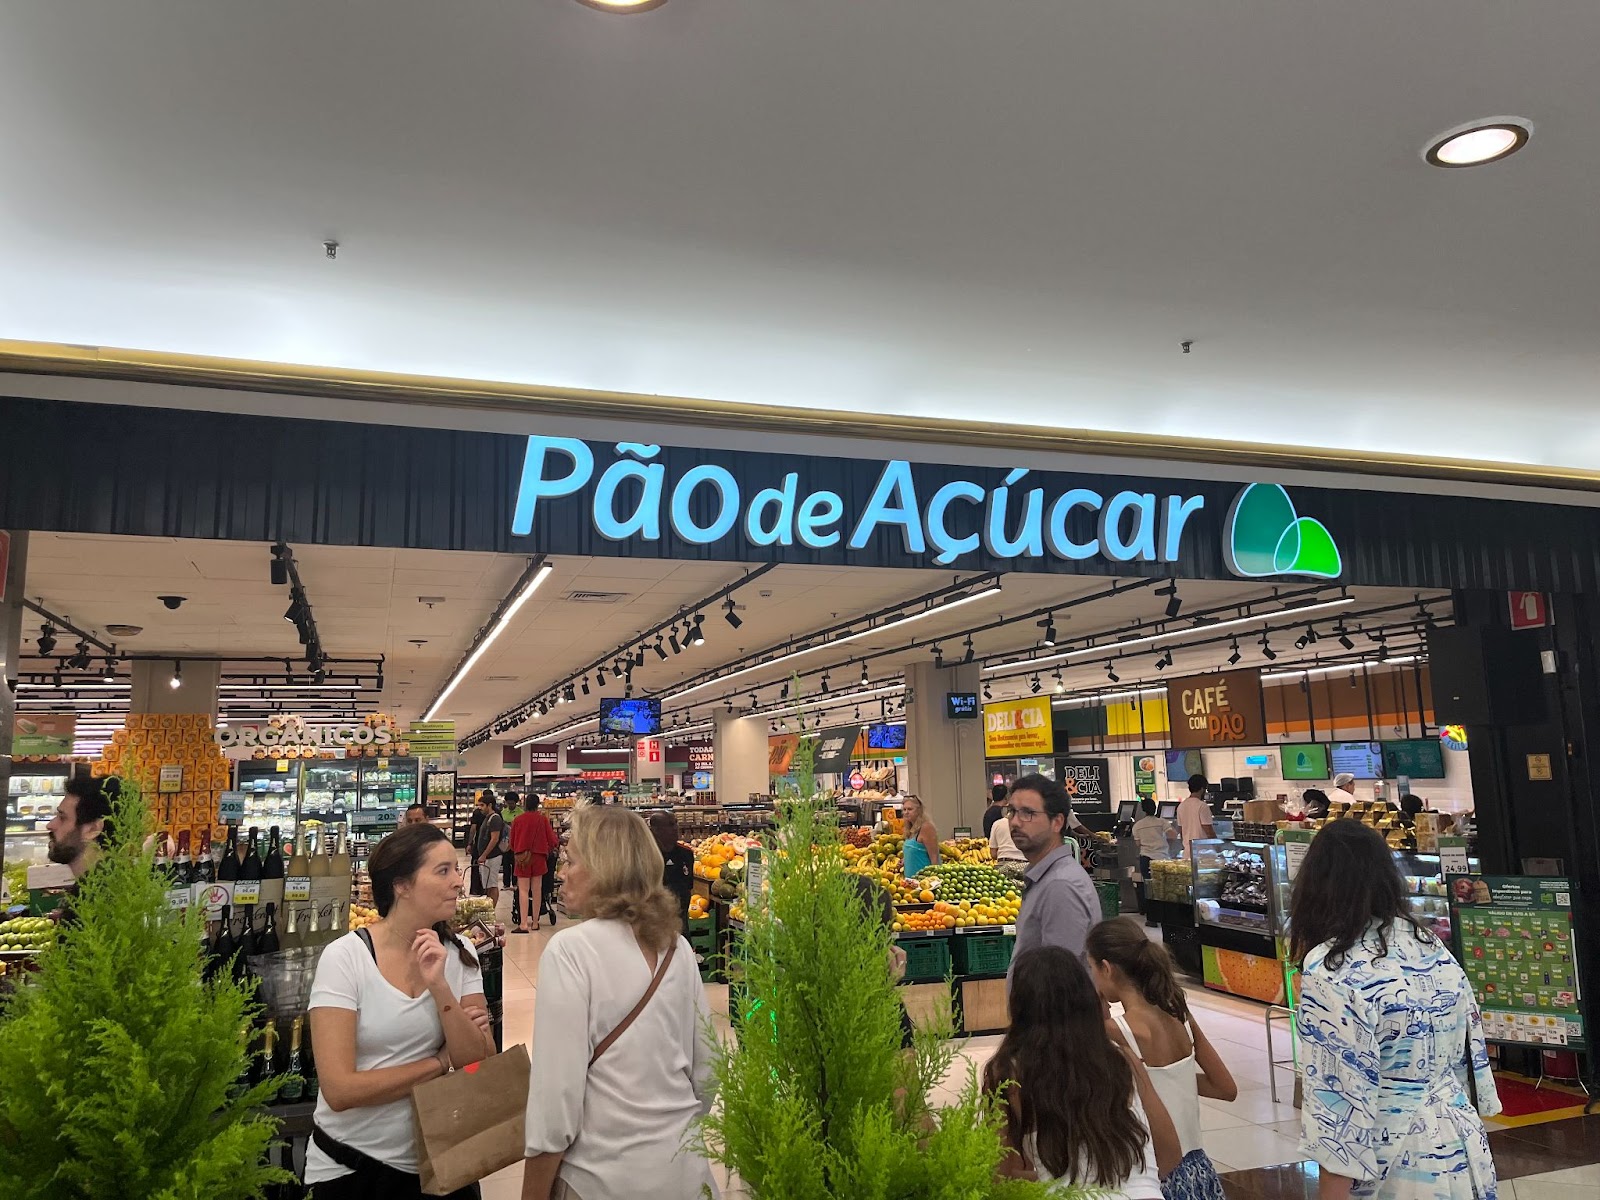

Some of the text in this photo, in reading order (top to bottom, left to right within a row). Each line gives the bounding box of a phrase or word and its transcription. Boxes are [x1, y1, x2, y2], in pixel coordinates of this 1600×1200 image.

[511, 434, 1206, 564] Pão de Açúcar
[950, 696, 976, 706] Wi-Fi
[1181, 678, 1229, 716] CAFÉ
[1188, 716, 1207, 730] COM
[213, 721, 392, 747] ORGÂNICOS
[1064, 766, 1100, 780] DELI
